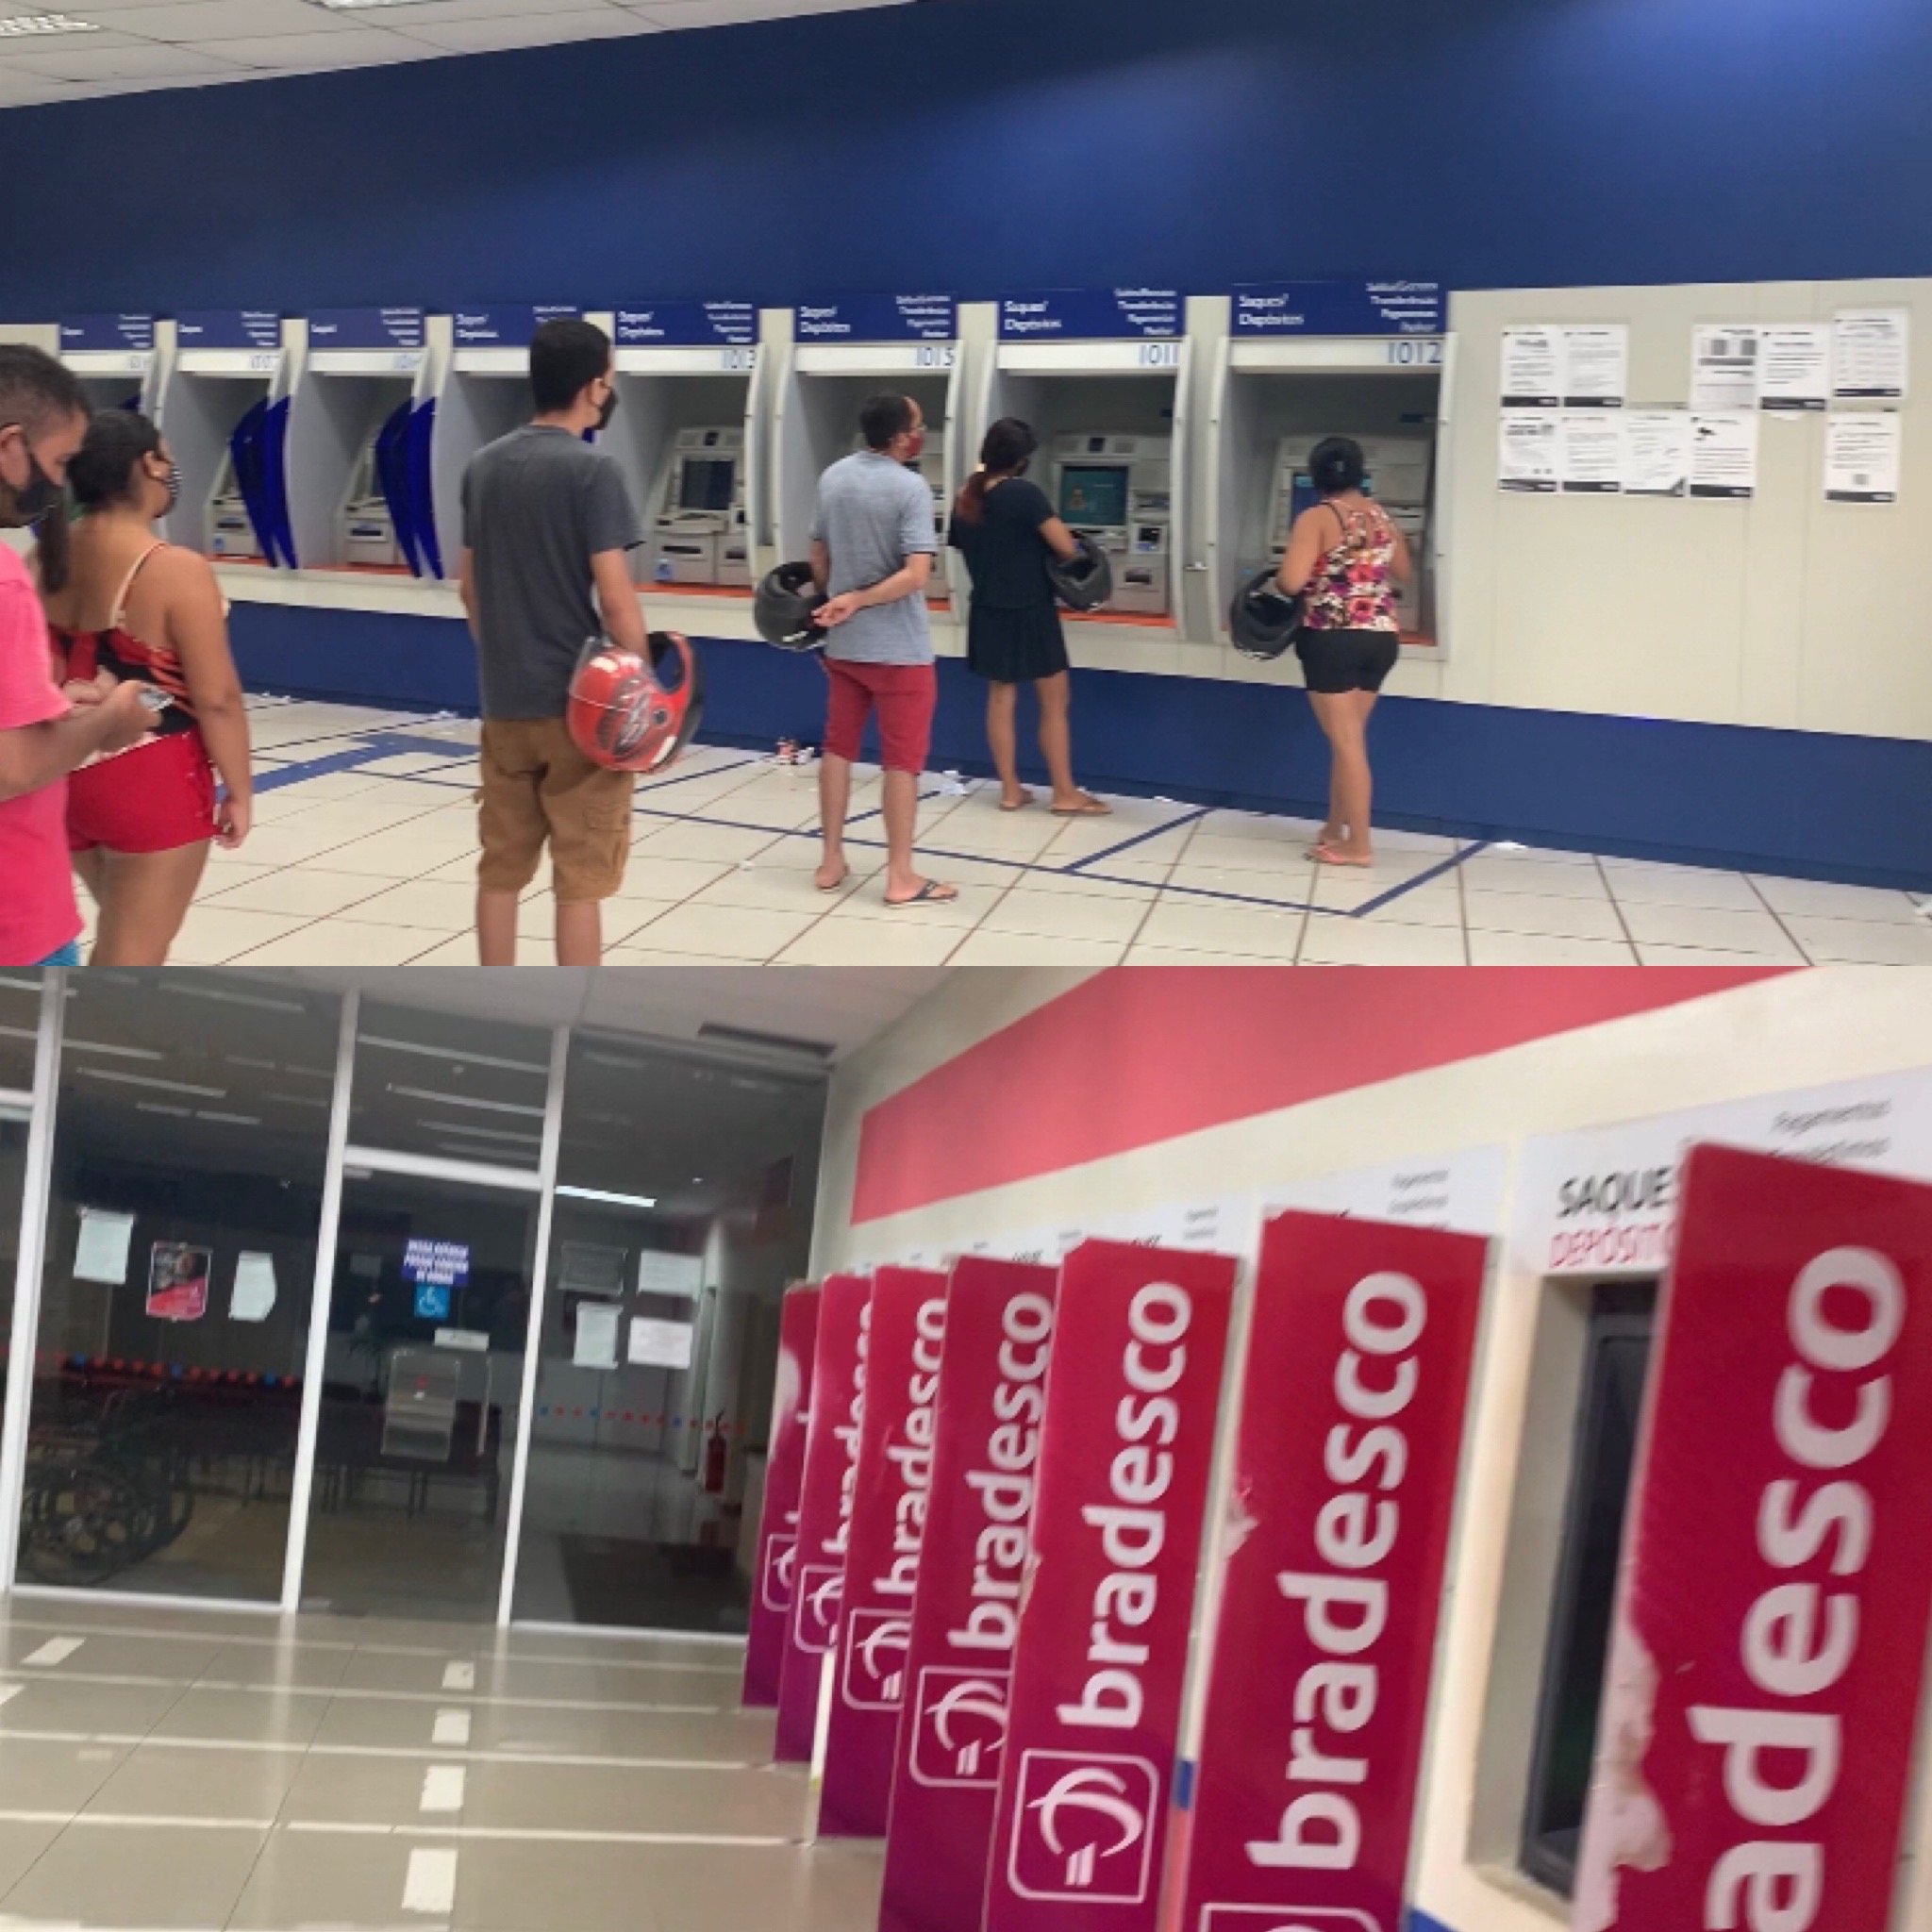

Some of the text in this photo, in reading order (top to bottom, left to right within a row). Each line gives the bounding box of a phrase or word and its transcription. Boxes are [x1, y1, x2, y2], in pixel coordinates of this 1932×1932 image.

[1388, 341, 1442, 364] 1012
[946, 1291, 1053, 1652] bradesco
[1056, 1282, 1191, 1728] bradesco
[1244, 1271, 1427, 1871] bradesco
[1686, 1244, 1907, 1931] adesco
